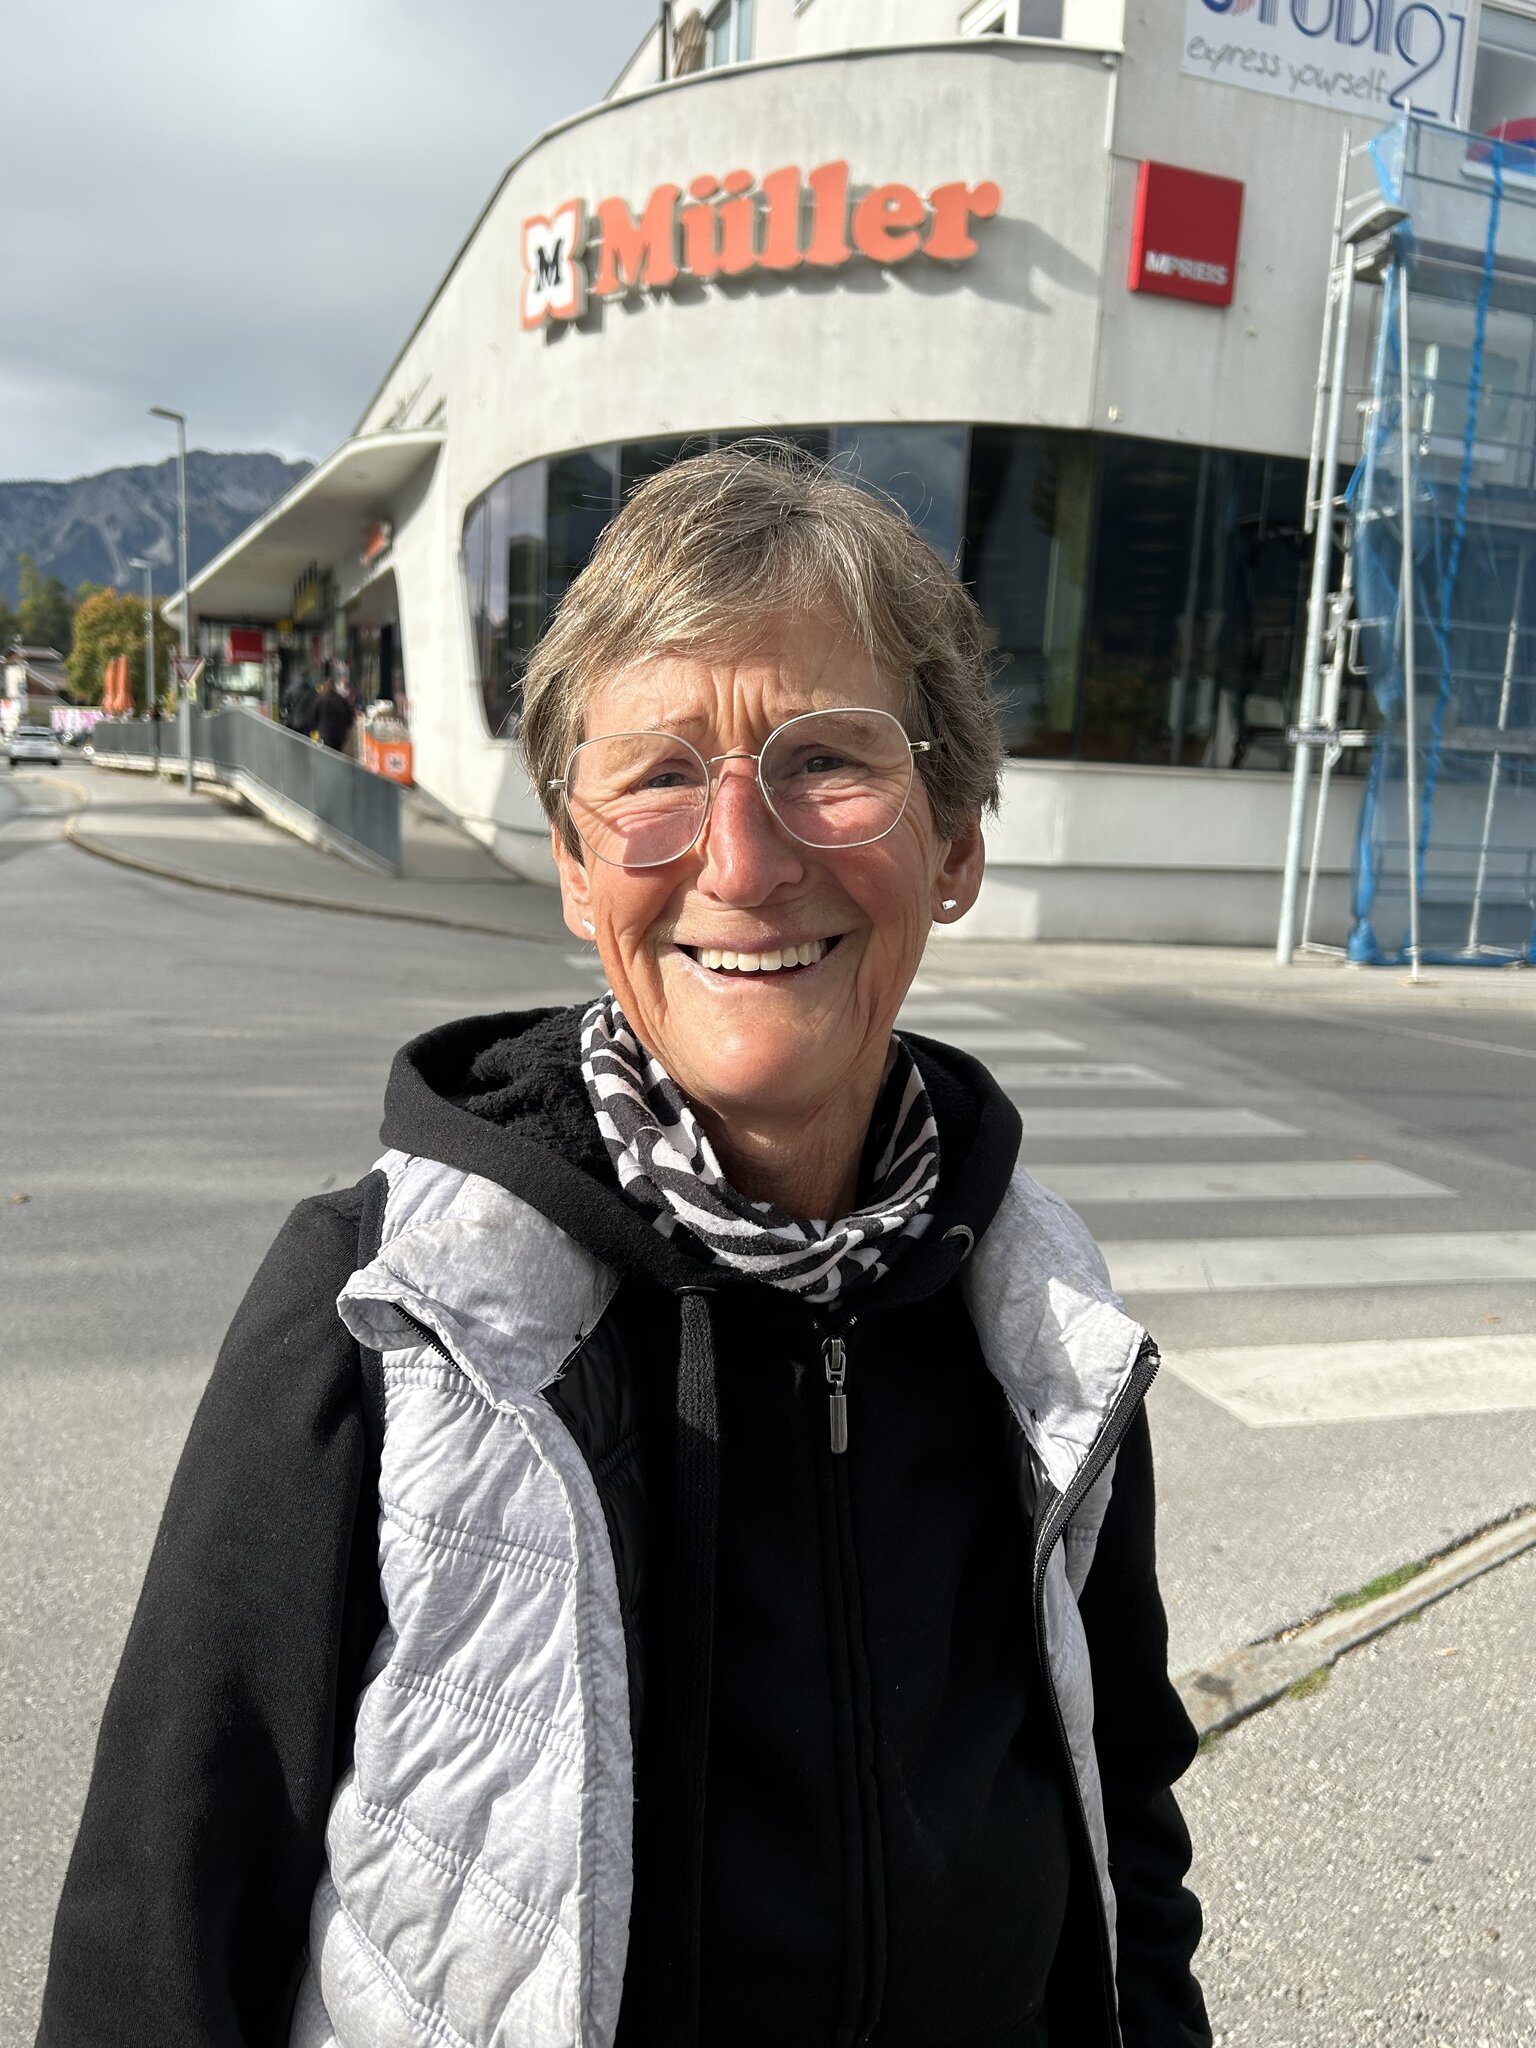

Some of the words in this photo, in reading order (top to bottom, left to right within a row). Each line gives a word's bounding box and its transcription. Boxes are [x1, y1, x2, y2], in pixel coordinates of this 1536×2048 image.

[1187, 35, 1281, 78] express
[1288, 62, 1392, 104] yourself
[533, 237, 564, 293] M
[592, 160, 1002, 296] Müller
[1144, 250, 1229, 286] MPREIS
